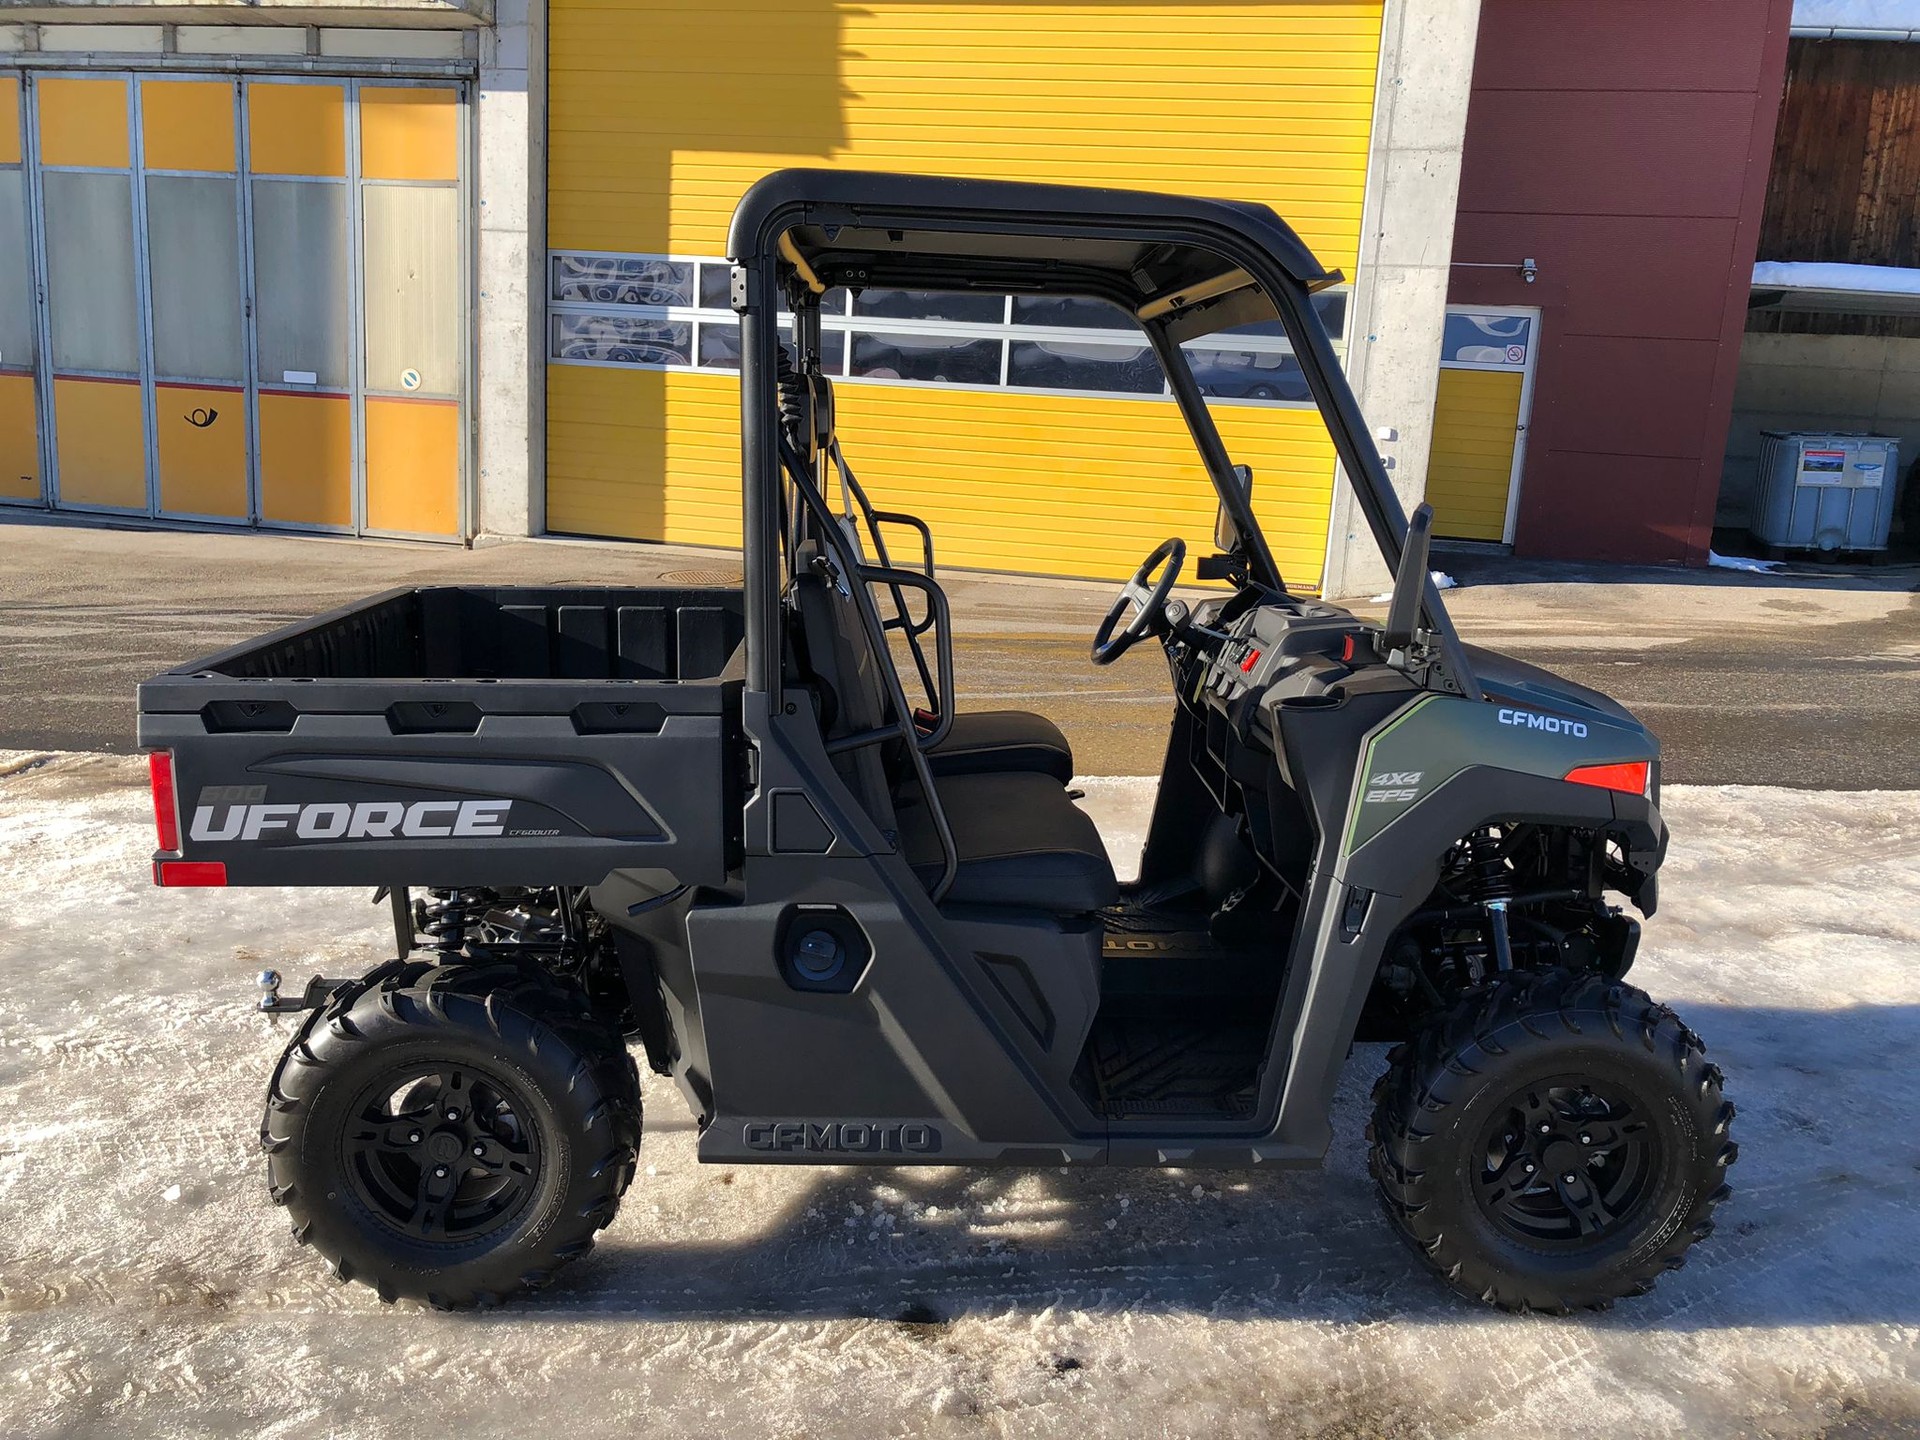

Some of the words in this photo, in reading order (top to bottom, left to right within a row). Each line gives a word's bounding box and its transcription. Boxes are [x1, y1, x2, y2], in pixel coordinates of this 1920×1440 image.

[1498, 708, 1588, 738] CFMOTO
[1365, 788, 1419, 803] EPS
[189, 799, 513, 842] UFORCE
[743, 1122, 942, 1153] CFMOTO
